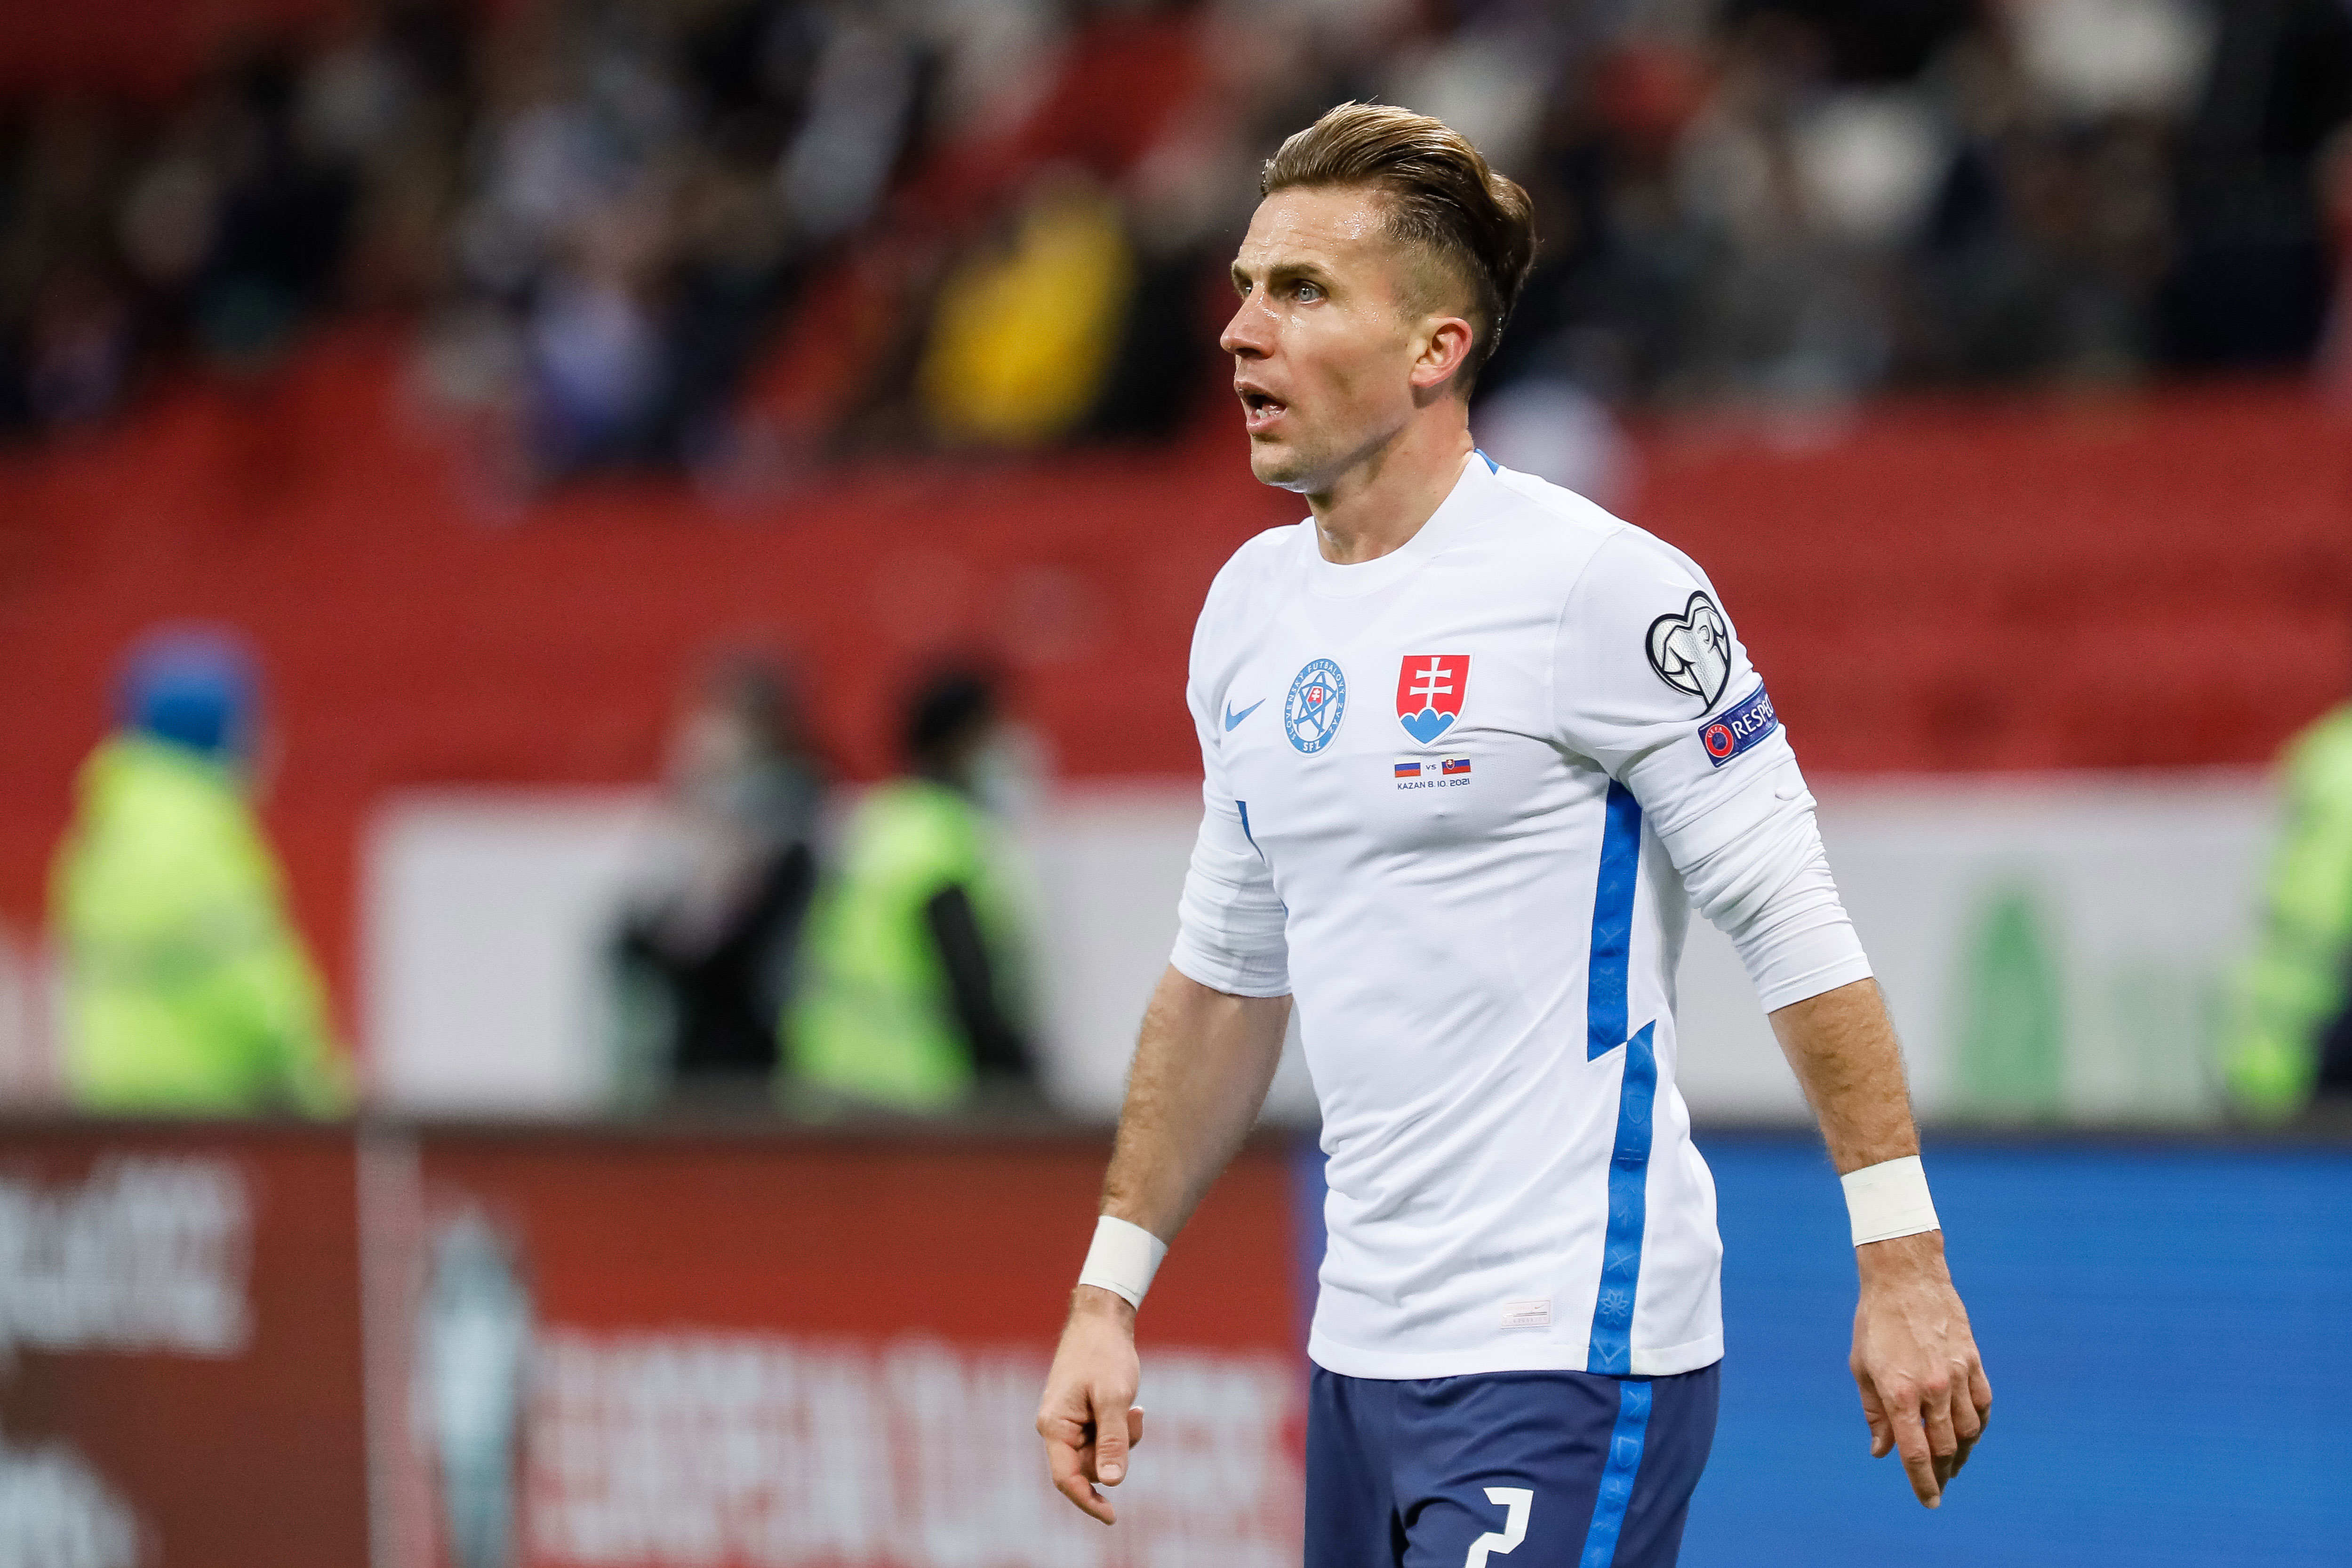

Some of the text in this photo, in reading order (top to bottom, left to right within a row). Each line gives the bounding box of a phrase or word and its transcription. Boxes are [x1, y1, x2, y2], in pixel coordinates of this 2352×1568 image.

[1731, 693, 1774, 739] RESPEC
[1707, 726, 1722, 738] UEFA
[1303, 739, 1321, 752] SFZ
[1397, 781, 1425, 790] KAZAN
[1450, 778, 1470, 786] 2021
